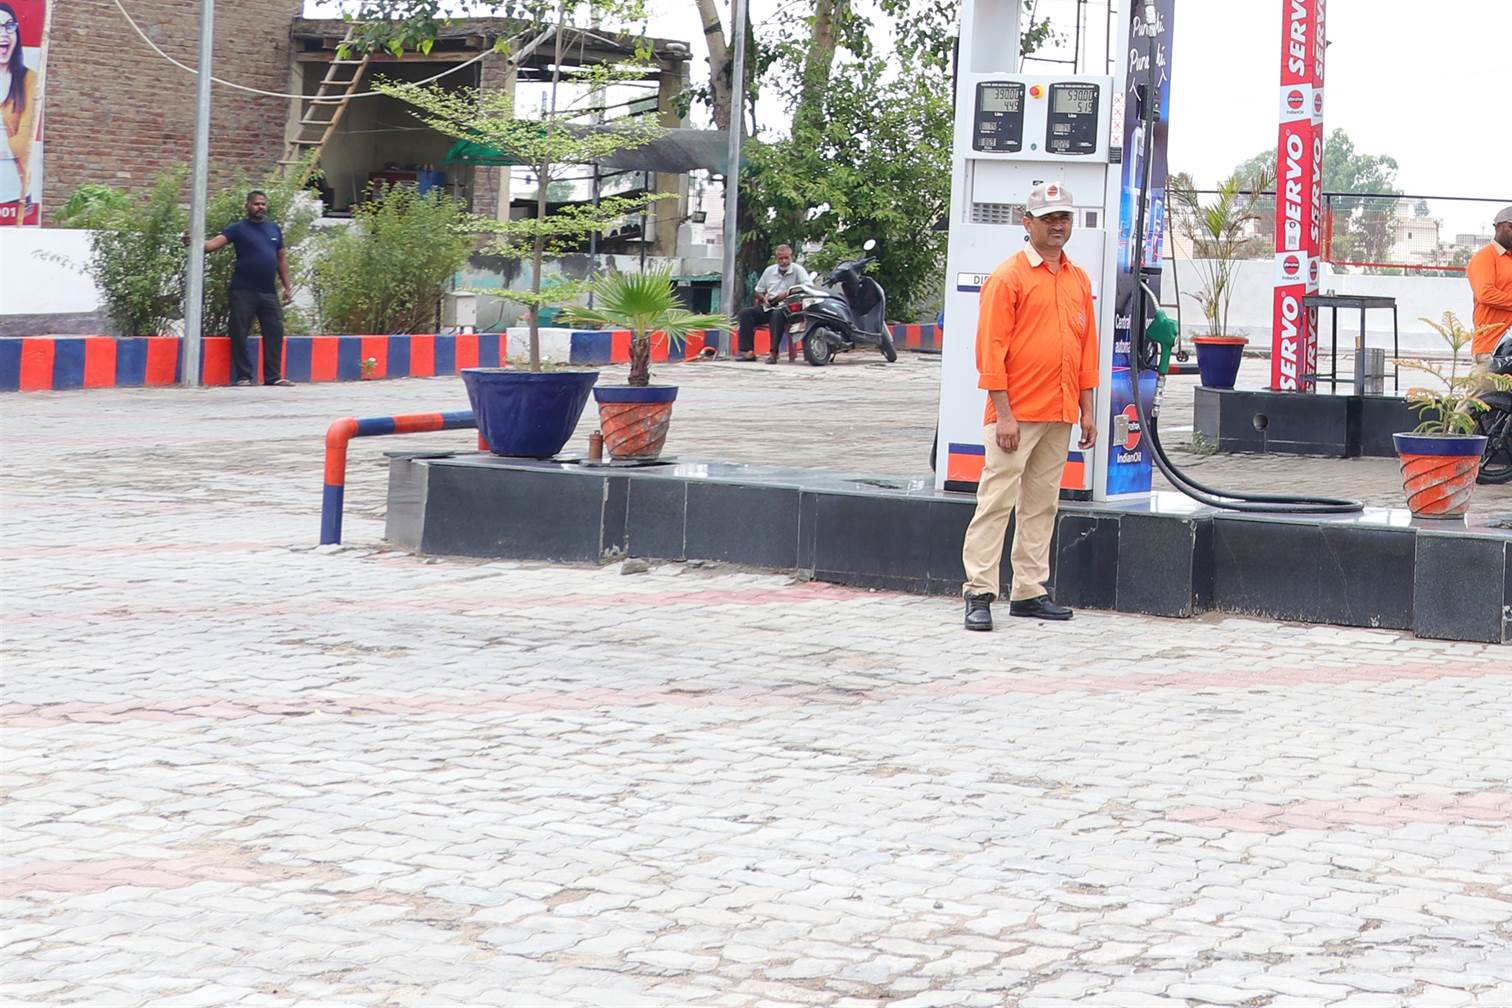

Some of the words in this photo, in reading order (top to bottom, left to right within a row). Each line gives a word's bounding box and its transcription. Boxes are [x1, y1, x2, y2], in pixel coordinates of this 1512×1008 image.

[1285, 133, 1304, 220] ERVO
[1311, 136, 1322, 242] SERVO
[1280, 295, 1300, 390] SERVO
[1116, 452, 1142, 464] IndianOil
